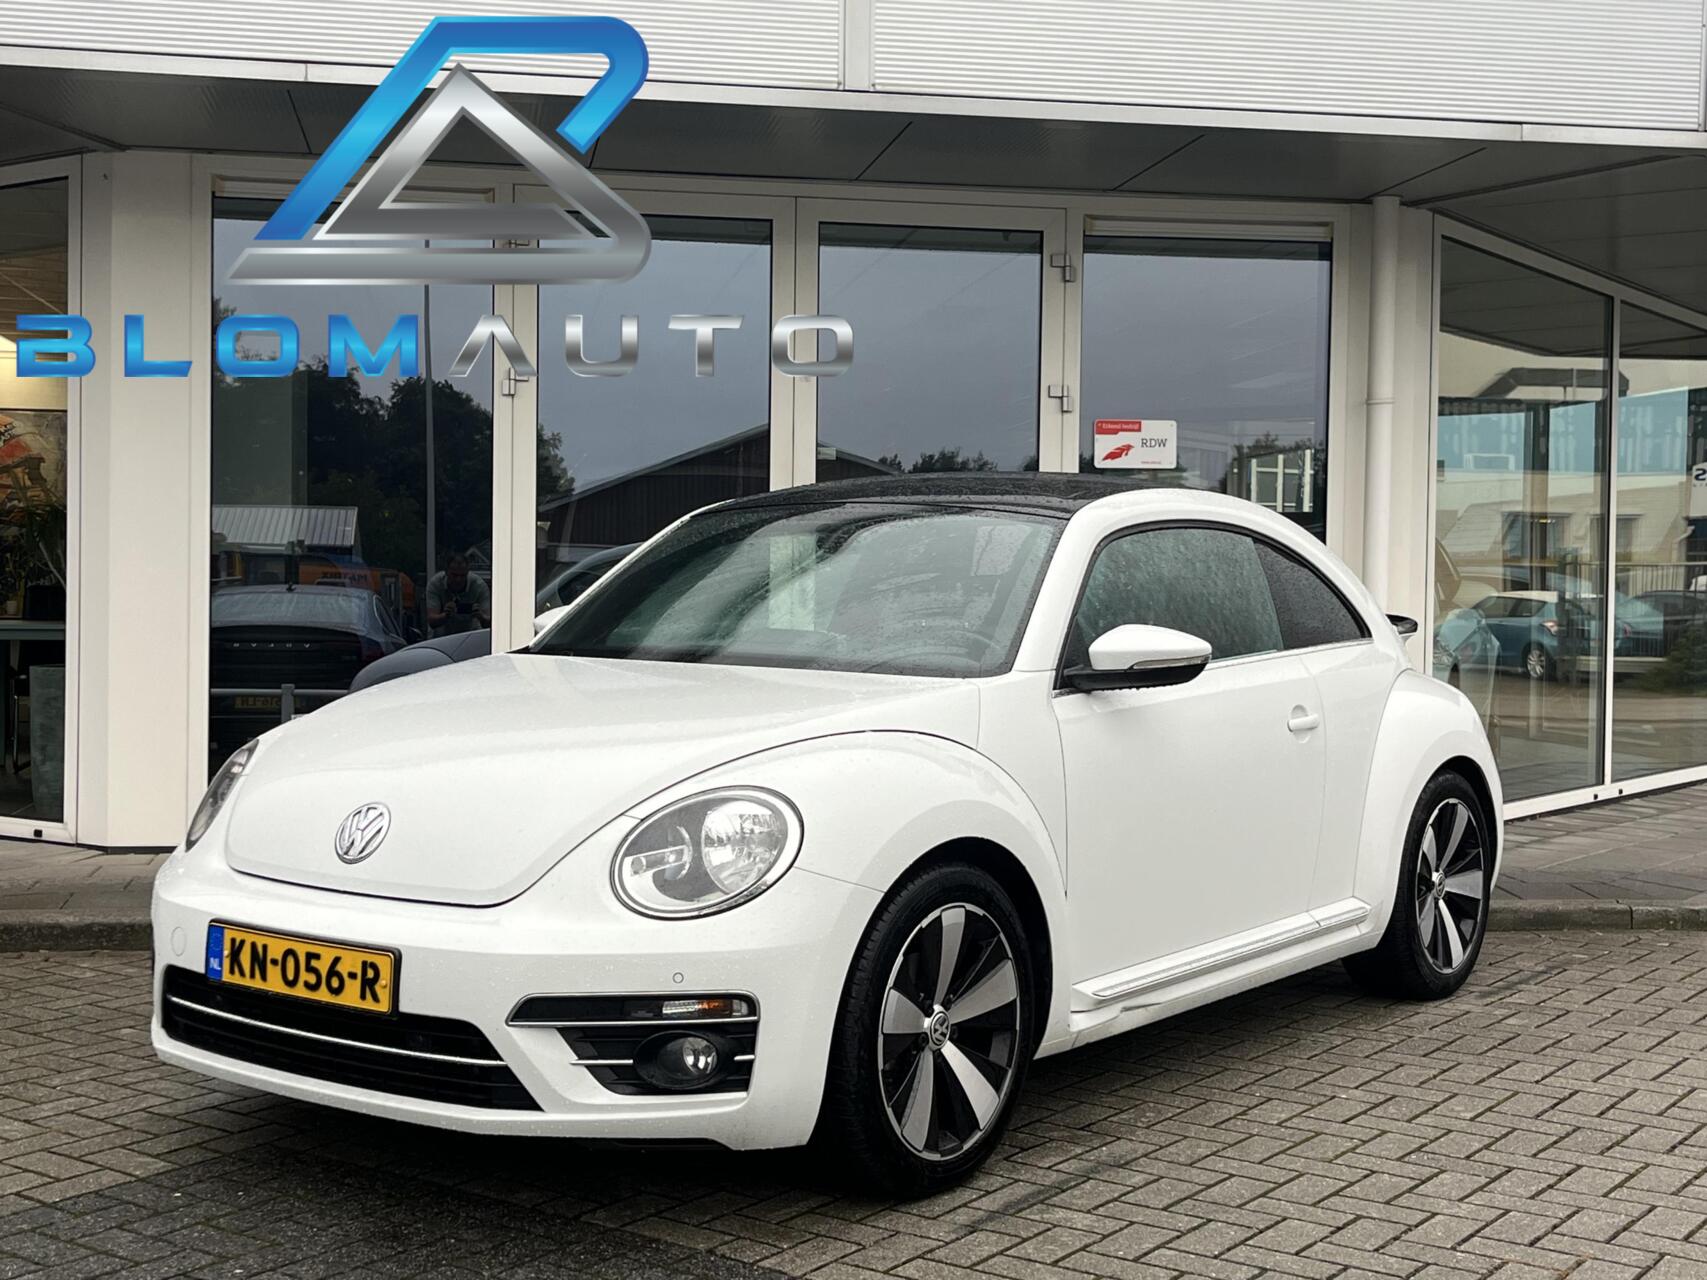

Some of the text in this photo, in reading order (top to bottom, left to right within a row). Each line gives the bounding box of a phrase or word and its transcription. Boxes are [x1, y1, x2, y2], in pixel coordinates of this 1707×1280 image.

[1141, 438, 1168, 448] RDW
[209, 957, 222, 970] NL
[228, 937, 381, 1003] KN-056-R
